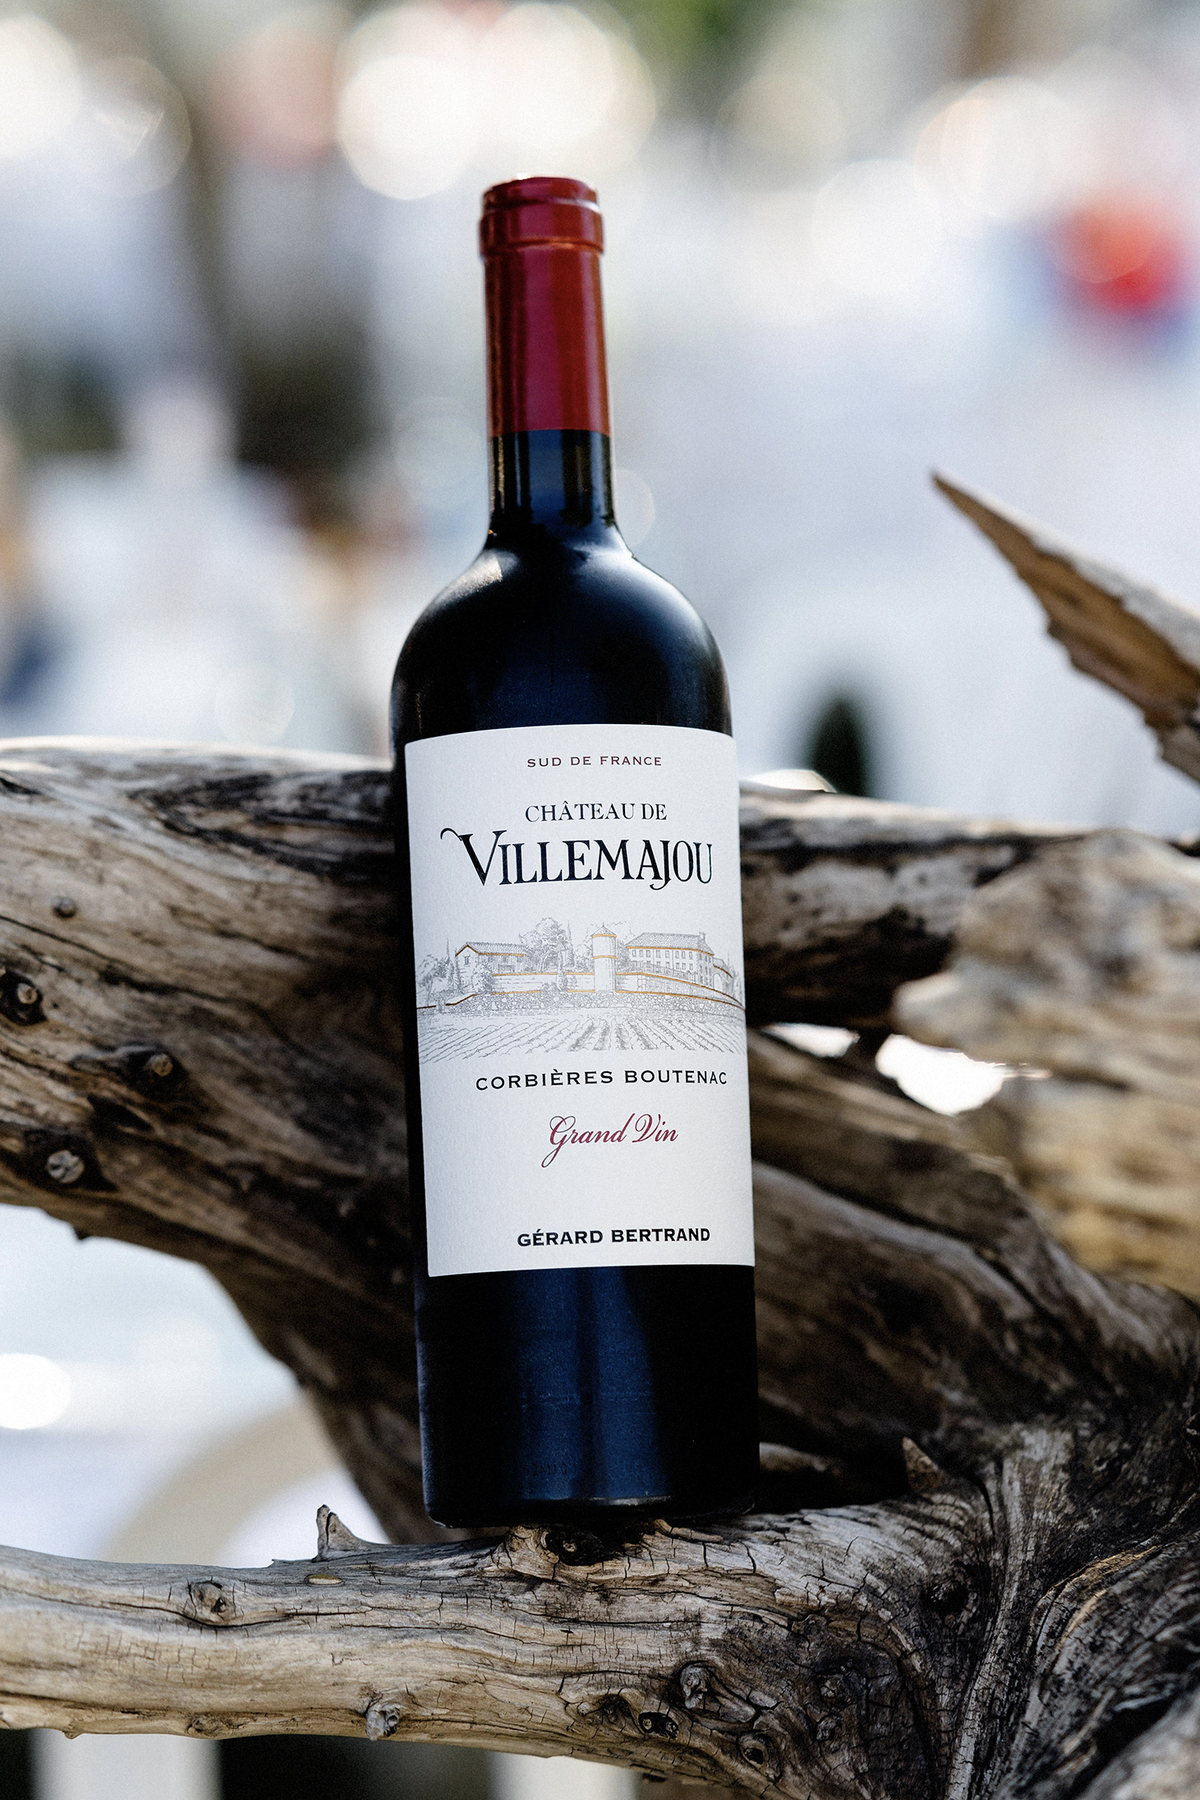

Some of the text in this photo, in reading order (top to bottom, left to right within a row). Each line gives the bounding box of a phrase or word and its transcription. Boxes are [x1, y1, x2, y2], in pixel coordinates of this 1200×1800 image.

[526, 755, 662, 768] SUD DE FRANCE
[524, 800, 668, 823] CHÂTEAU DE
[439, 827, 713, 891] VILLEMAJOU
[475, 1068, 728, 1091] CORBIÈRES BOUTENAC
[540, 1112, 679, 1169] Grand Vin
[516, 1227, 711, 1248] GÉRARD BERTRAND
